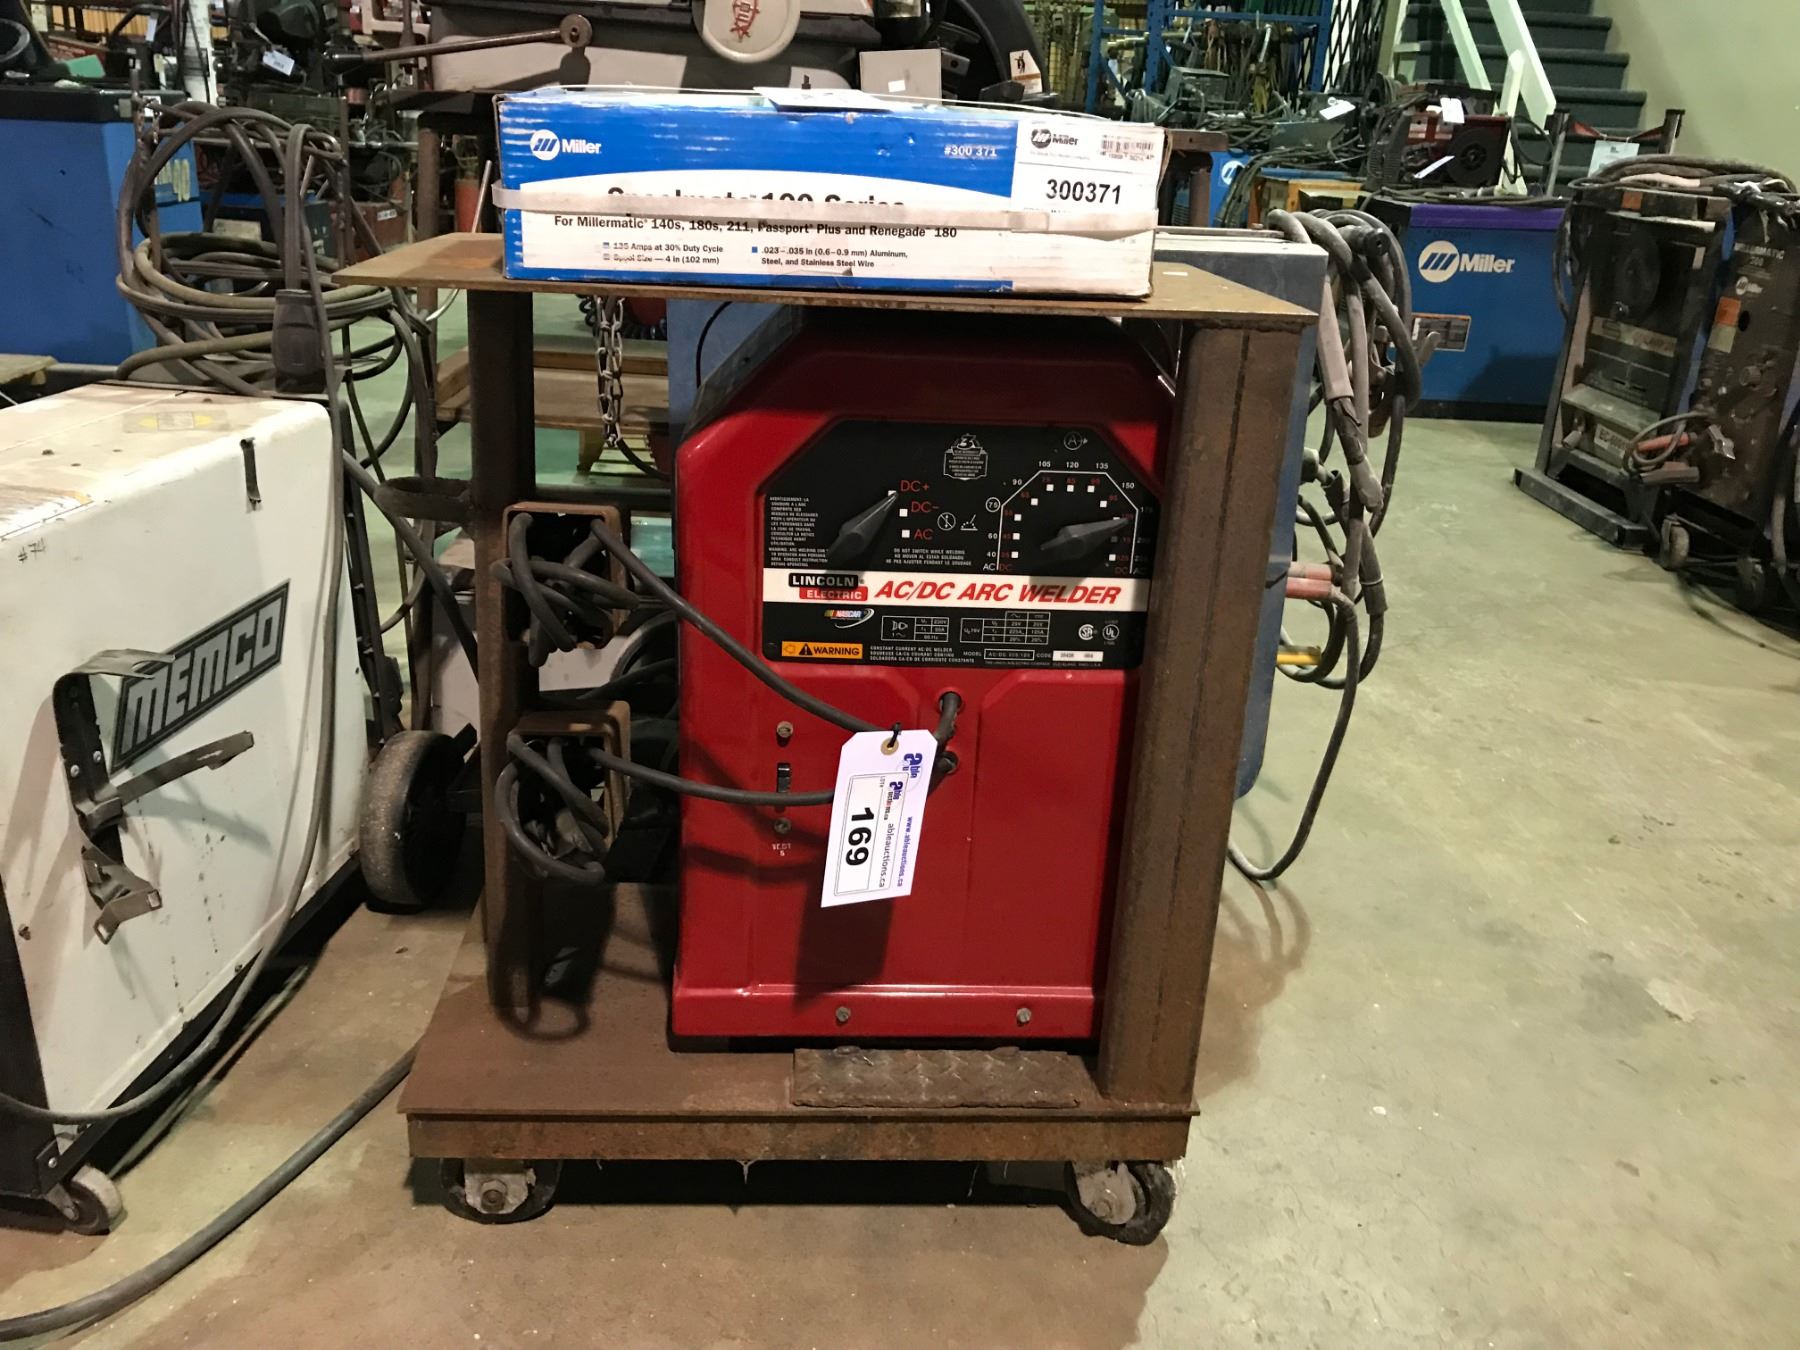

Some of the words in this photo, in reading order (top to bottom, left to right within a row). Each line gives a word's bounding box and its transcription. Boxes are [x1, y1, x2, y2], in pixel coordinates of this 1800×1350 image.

[562, 138, 601, 154] Miller
[944, 145, 972, 156] #300
[975, 146, 997, 158] 371
[1046, 179, 1121, 204] 300371
[554, 216, 574, 226] For
[651, 218, 685, 231] 140s,
[688, 220, 723, 232] 180s,
[726, 220, 754, 234] 211,
[816, 224, 842, 235] Plus
[844, 224, 866, 236] and
[934, 227, 958, 238] 180
[631, 243, 652, 252] Amps
[683, 245, 700, 253] Duty
[702, 245, 724, 254] Cycle
[851, 249, 868, 258] mm)
[870, 250, 908, 259] Aluminum,
[682, 256, 700, 264] (102
[761, 258, 783, 266] Steel,
[801, 258, 834, 267] Stainless
[1460, 254, 1516, 273] Miller
[900, 480, 930, 493] DC+
[914, 528, 933, 541] AC
[982, 562, 996, 572] AC
[792, 576, 854, 588] LINCOLN
[806, 588, 863, 600] ELECTRIC
[875, 580, 956, 600] AC/DC
[957, 582, 1014, 602] ARC
[1018, 584, 1122, 604] WELDER
[813, 646, 860, 656] WARNING
[120, 597, 282, 756] MEMCO
[846, 807, 875, 866] 169
[879, 823, 896, 888] ableauctions.ca
[897, 816, 913, 888] www.ableauctions.ca
